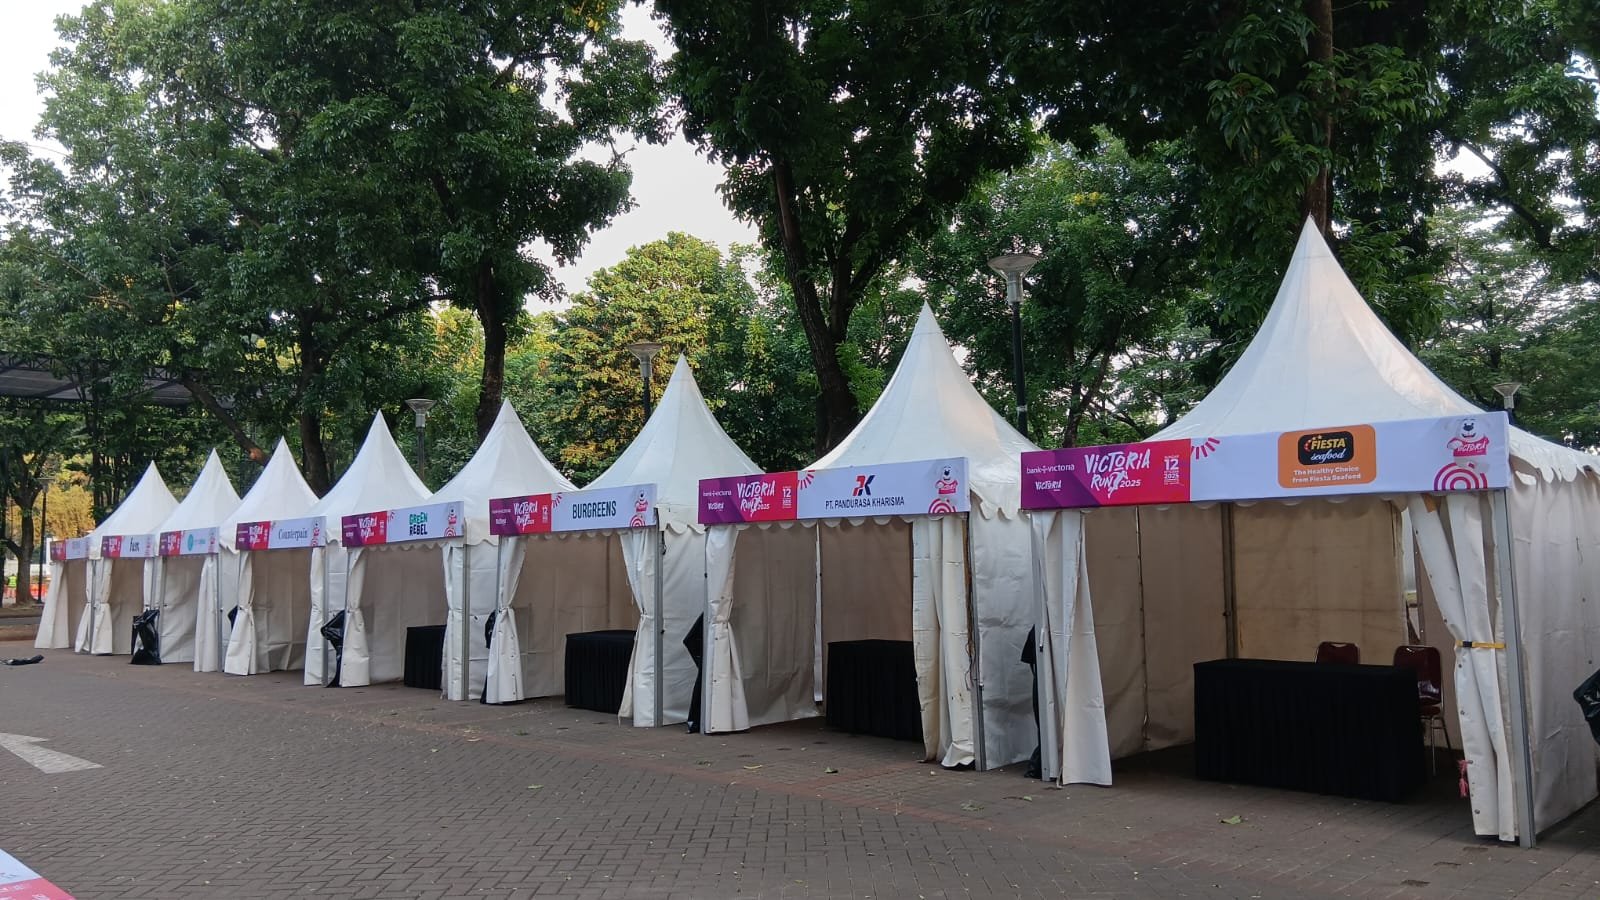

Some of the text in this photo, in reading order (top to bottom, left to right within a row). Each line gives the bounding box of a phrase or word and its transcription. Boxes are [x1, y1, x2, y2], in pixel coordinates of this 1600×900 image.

[1311, 438, 1346, 449] FIESTA
[1310, 448, 1346, 463] seafood
[1164, 458, 1179, 470] 12
[1090, 474, 1141, 491] RUN 2025
[782, 488, 791, 498] 12
[572, 500, 617, 519] BURGREENS
[825, 496, 905, 510] PT. PANDURASA KHARISMA
[409, 511, 428, 525] GREEN
[278, 527, 308, 541] Counterpain
[409, 524, 428, 536] REBEL
